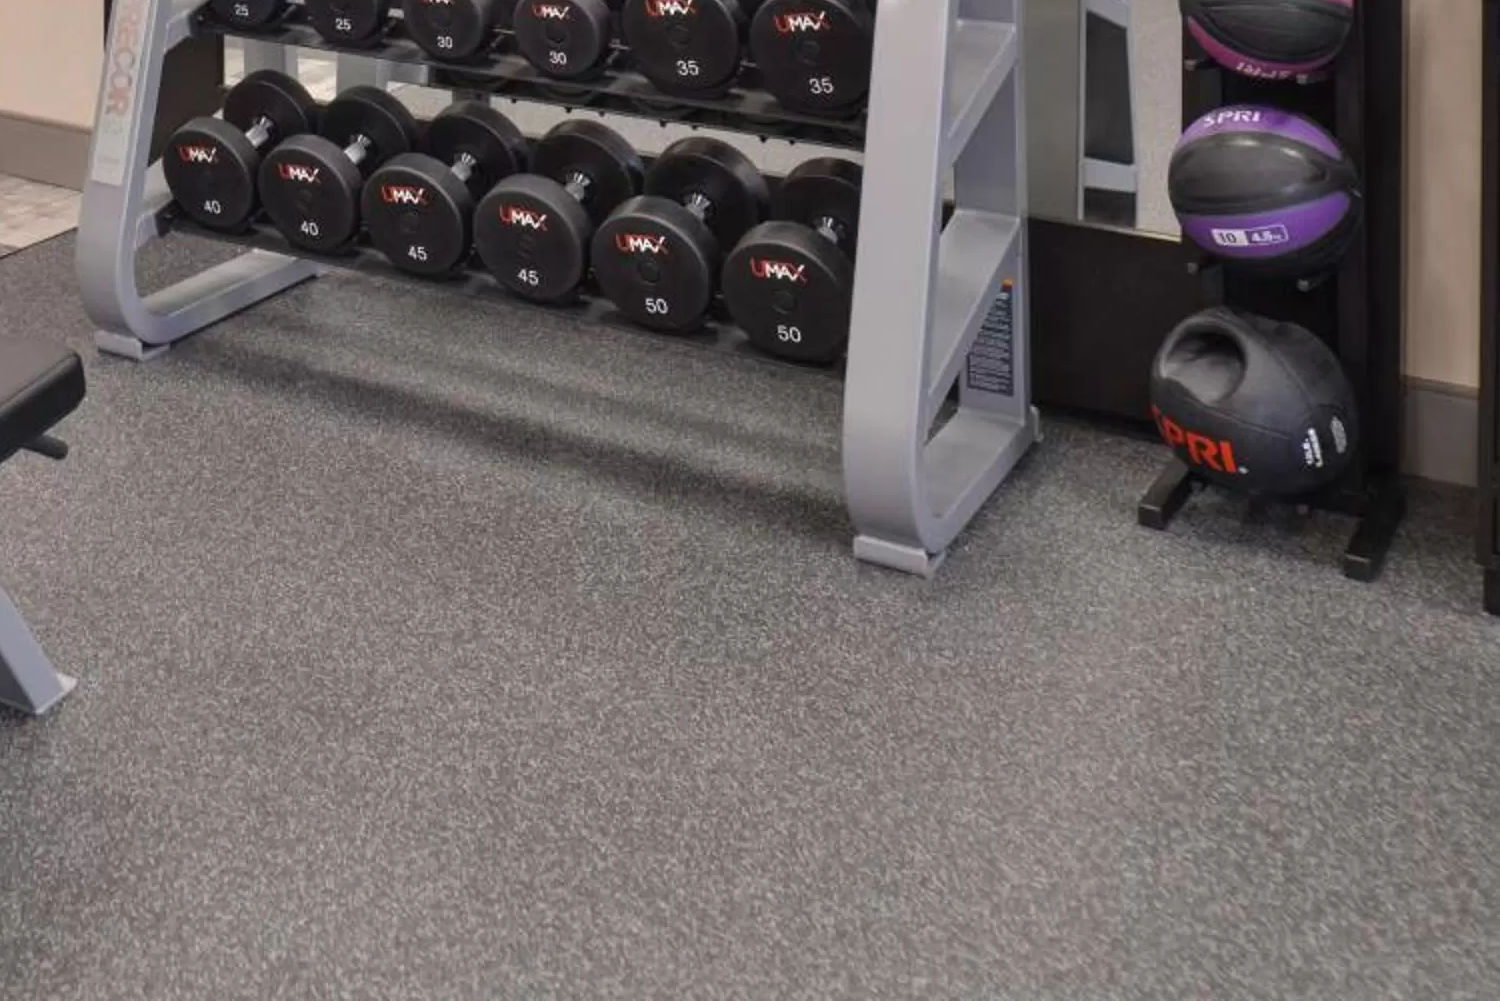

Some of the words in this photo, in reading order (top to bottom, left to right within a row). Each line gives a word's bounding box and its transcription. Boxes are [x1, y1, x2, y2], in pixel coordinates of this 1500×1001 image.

[233, 3, 250, 17] 25
[334, 17, 352, 31] 25
[772, 9, 831, 34] UMAX
[436, 34, 454, 50] 30
[548, 50, 568, 66] 30
[675, 59, 699, 77] 35
[807, 76, 834, 95] 35
[1203, 110, 1260, 129] SPRI
[202, 199, 222, 215] 40
[499, 204, 549, 231] UMAX
[299, 220, 320, 237] 40
[1218, 231, 1238, 244] 10
[615, 232, 669, 256] UMAX
[406, 246, 428, 262] 45
[516, 268, 540, 286] 45
[750, 255, 808, 284] UMAX
[644, 297, 669, 315] 50
[776, 323, 803, 344] 50
